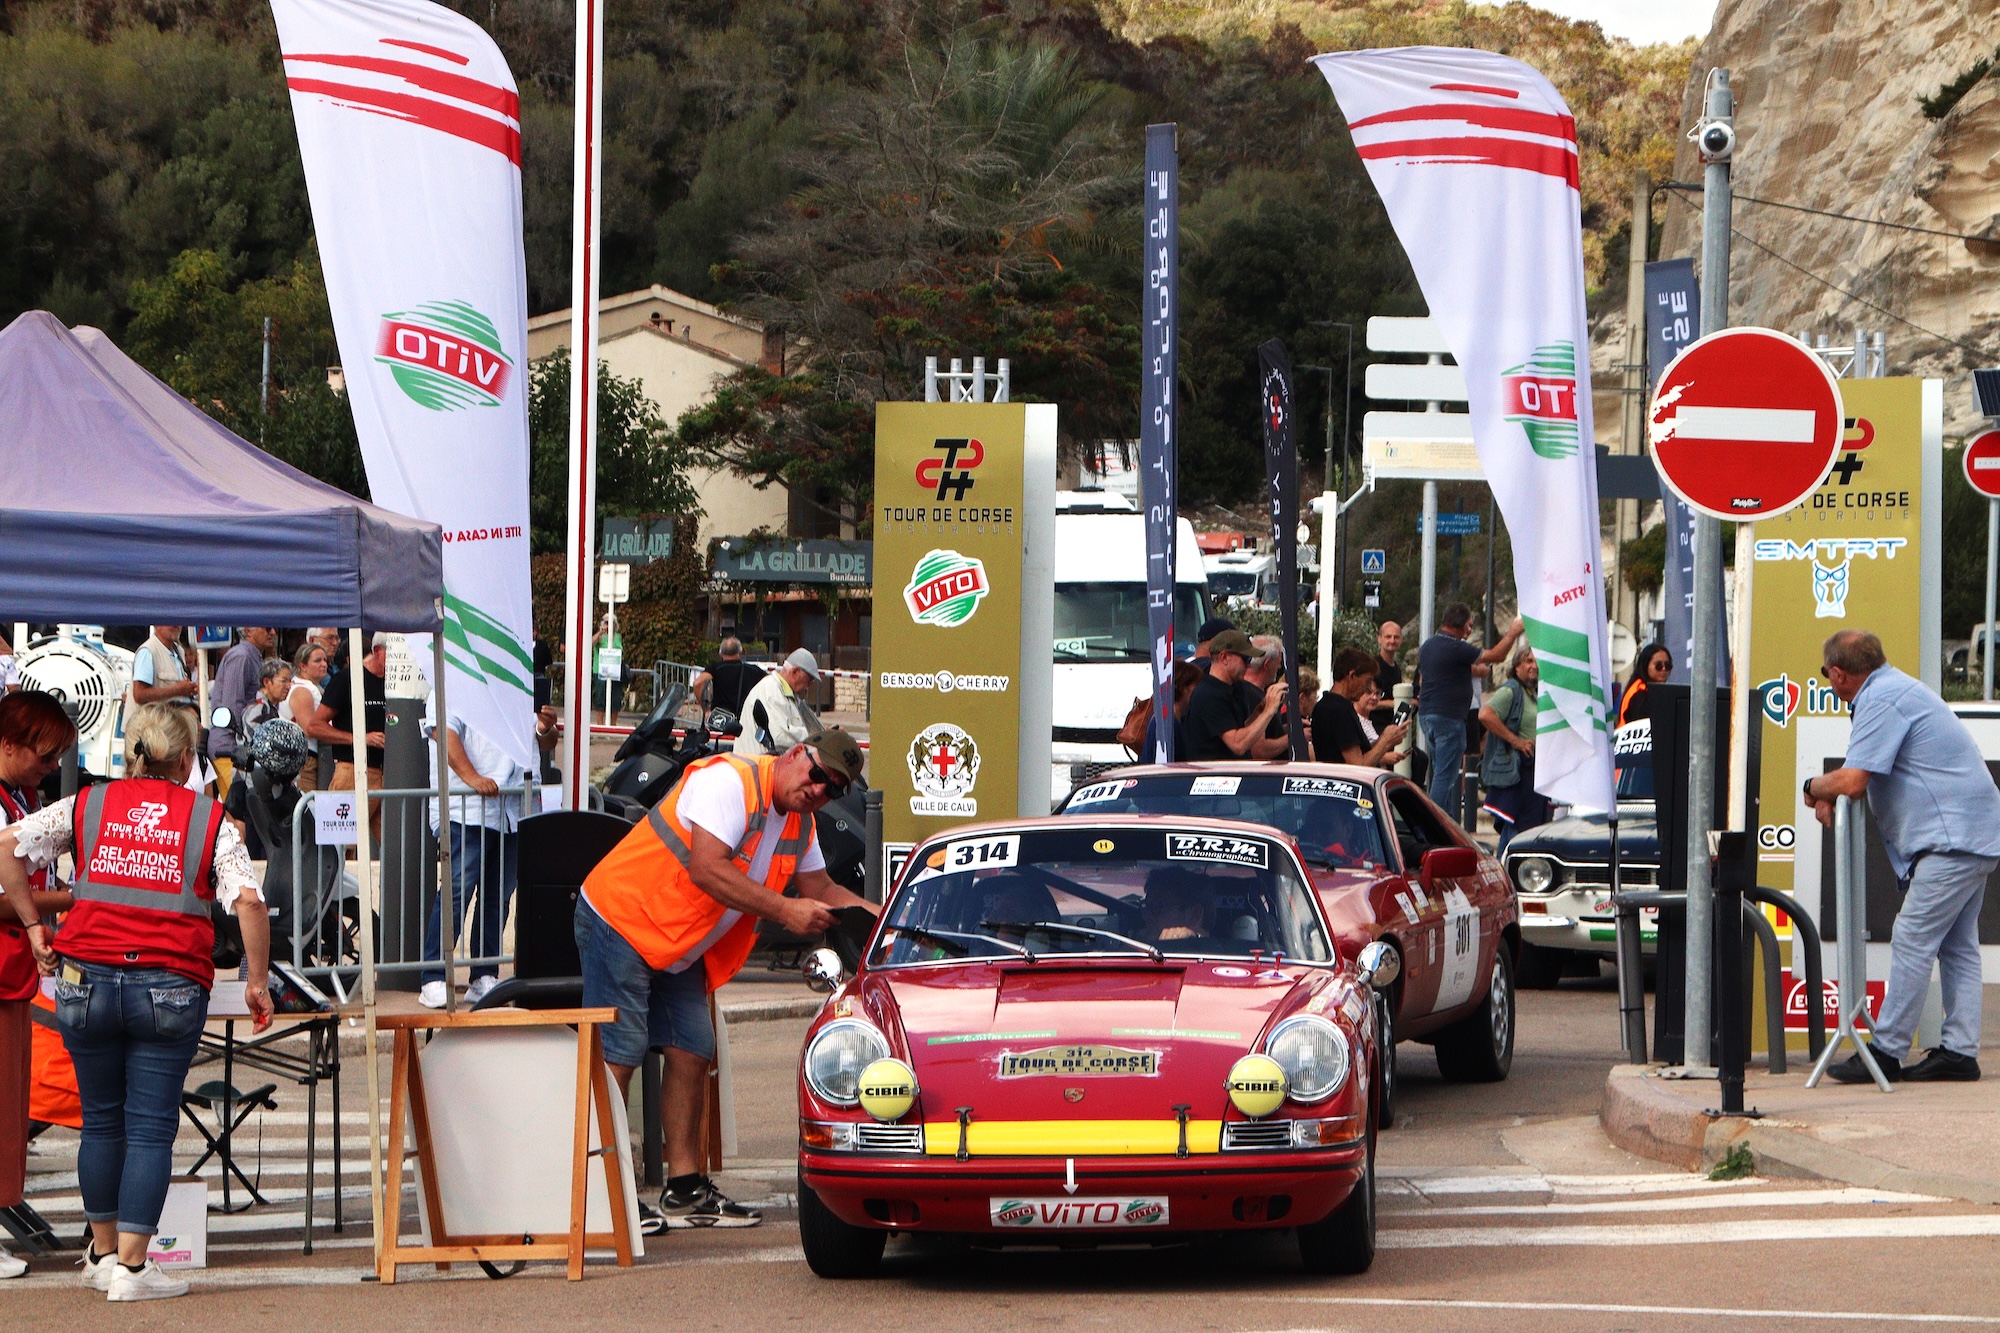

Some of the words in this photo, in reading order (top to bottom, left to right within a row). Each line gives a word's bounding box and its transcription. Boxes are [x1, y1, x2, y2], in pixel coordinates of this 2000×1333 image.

[1813, 493, 1837, 508] DE
[1845, 491, 1909, 508] CORSE
[883, 507, 926, 523] TOUR
[932, 507, 952, 523] DE
[959, 507, 1013, 523] CORSE
[883, 524, 1014, 535] HISTORIQUE
[604, 534, 618, 556] LA
[739, 551, 766, 571] LA
[768, 551, 866, 574] GRILLADE
[829, 573, 865, 582] Bunifaziu
[883, 674, 933, 687] BENSON
[956, 676, 1007, 689] CHERRY
[1076, 784, 1118, 801] 301
[913, 801, 935, 810] VILLE
[937, 802, 949, 811] DE
[951, 802, 975, 812] CALVI
[104, 830, 180, 846] HISTORIQUE
[106, 822, 133, 834] TOUR
[133, 826, 146, 836] DE
[148, 828, 181, 840] CORSE
[98, 845, 179, 869] RELATIONS
[955, 841, 1009, 866] 314
[90, 858, 182, 884] CONCURRENTS
[1455, 913, 1471, 956] 301
[1066, 1049, 1093, 1057] 314
[1009, 1057, 1056, 1069] TOUR
[1062, 1058, 1084, 1068] DE
[1089, 1055, 1150, 1068] CORSE
